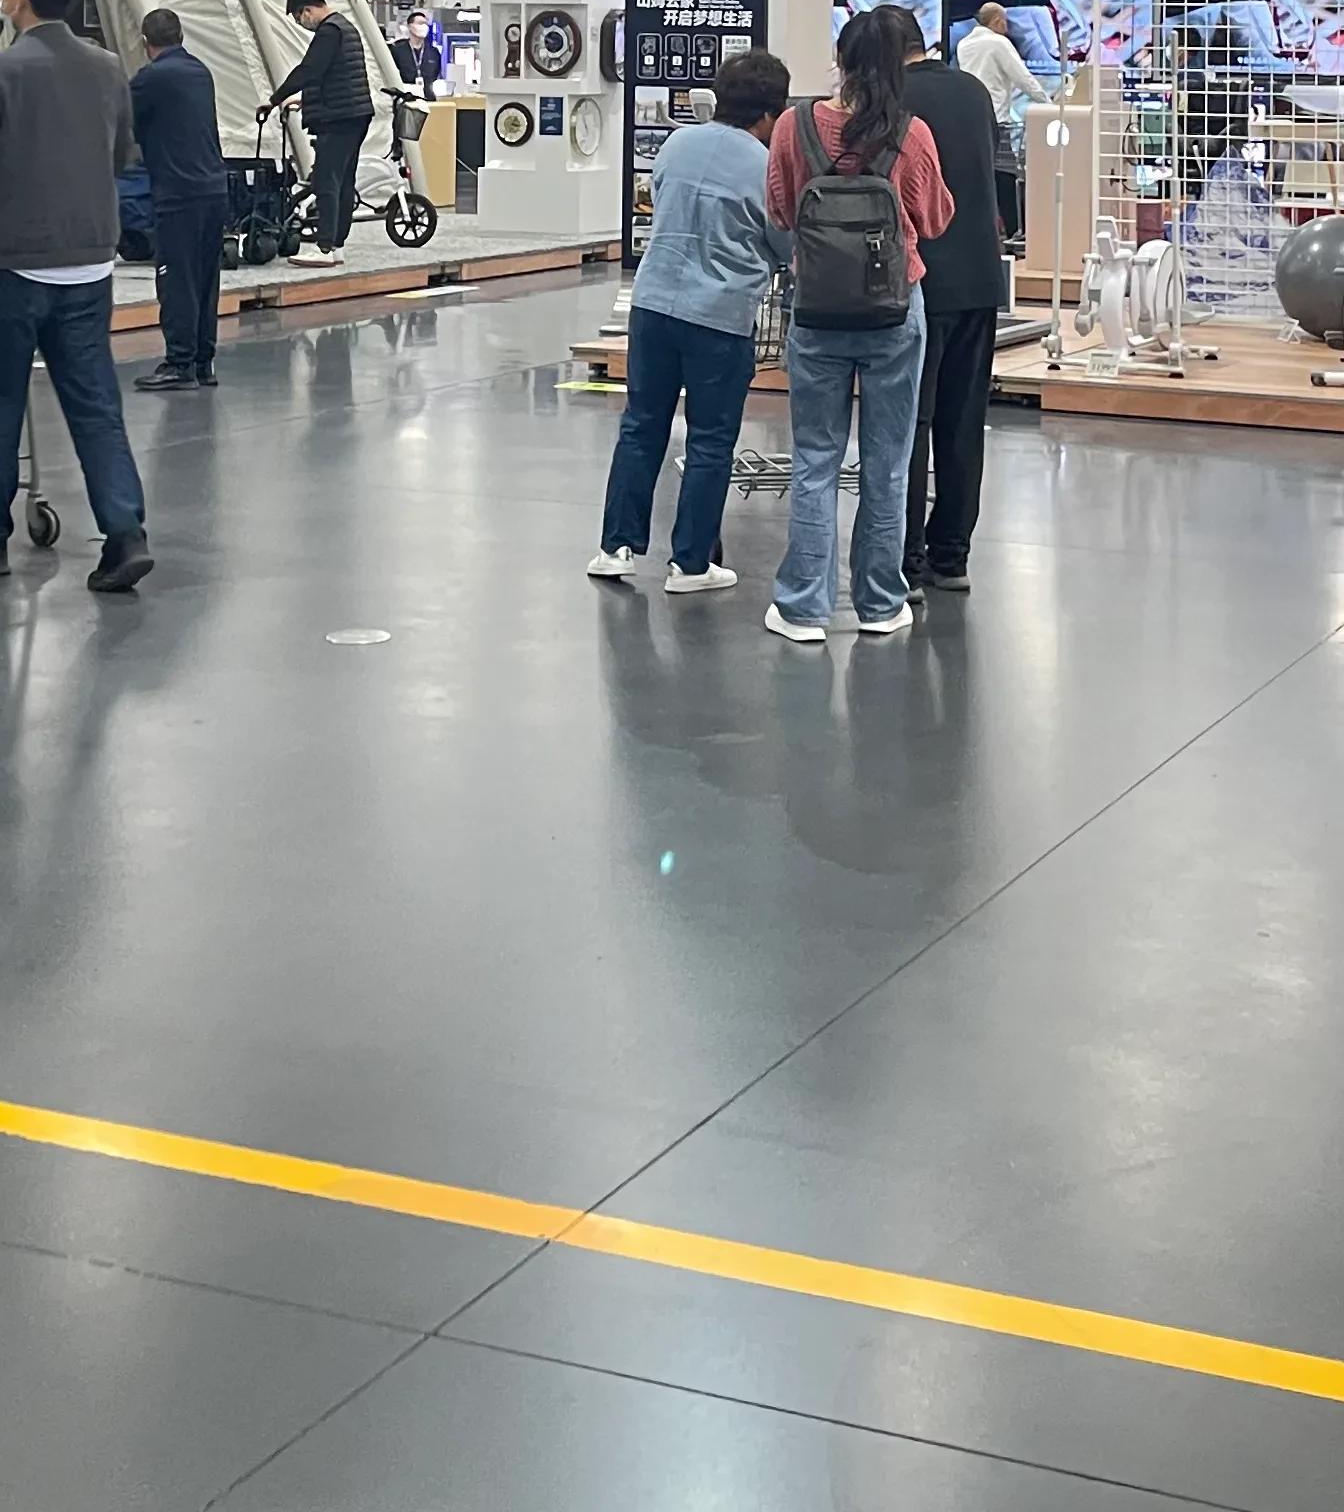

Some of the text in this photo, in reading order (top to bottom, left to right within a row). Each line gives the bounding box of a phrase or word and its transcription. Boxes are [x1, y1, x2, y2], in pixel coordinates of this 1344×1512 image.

[663, 9, 753, 28] 开启梦想生活
